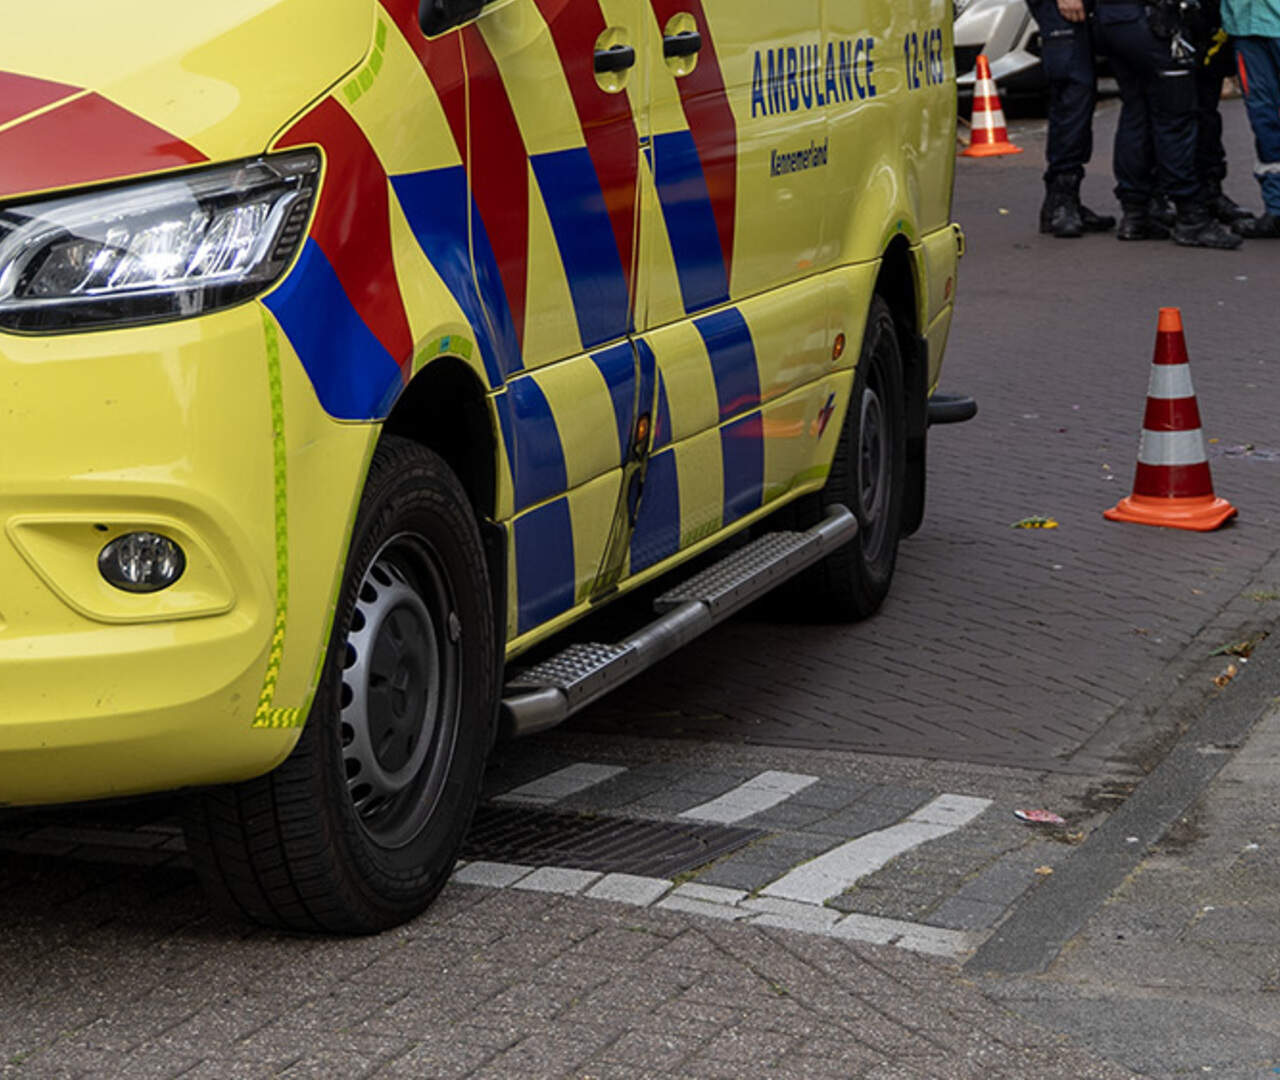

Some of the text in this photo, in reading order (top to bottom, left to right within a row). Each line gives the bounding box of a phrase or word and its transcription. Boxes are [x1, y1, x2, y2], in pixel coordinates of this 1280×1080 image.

[751, 28, 945, 118] AMBULANCE 12-163
[770, 136, 829, 177] Kennemerland
